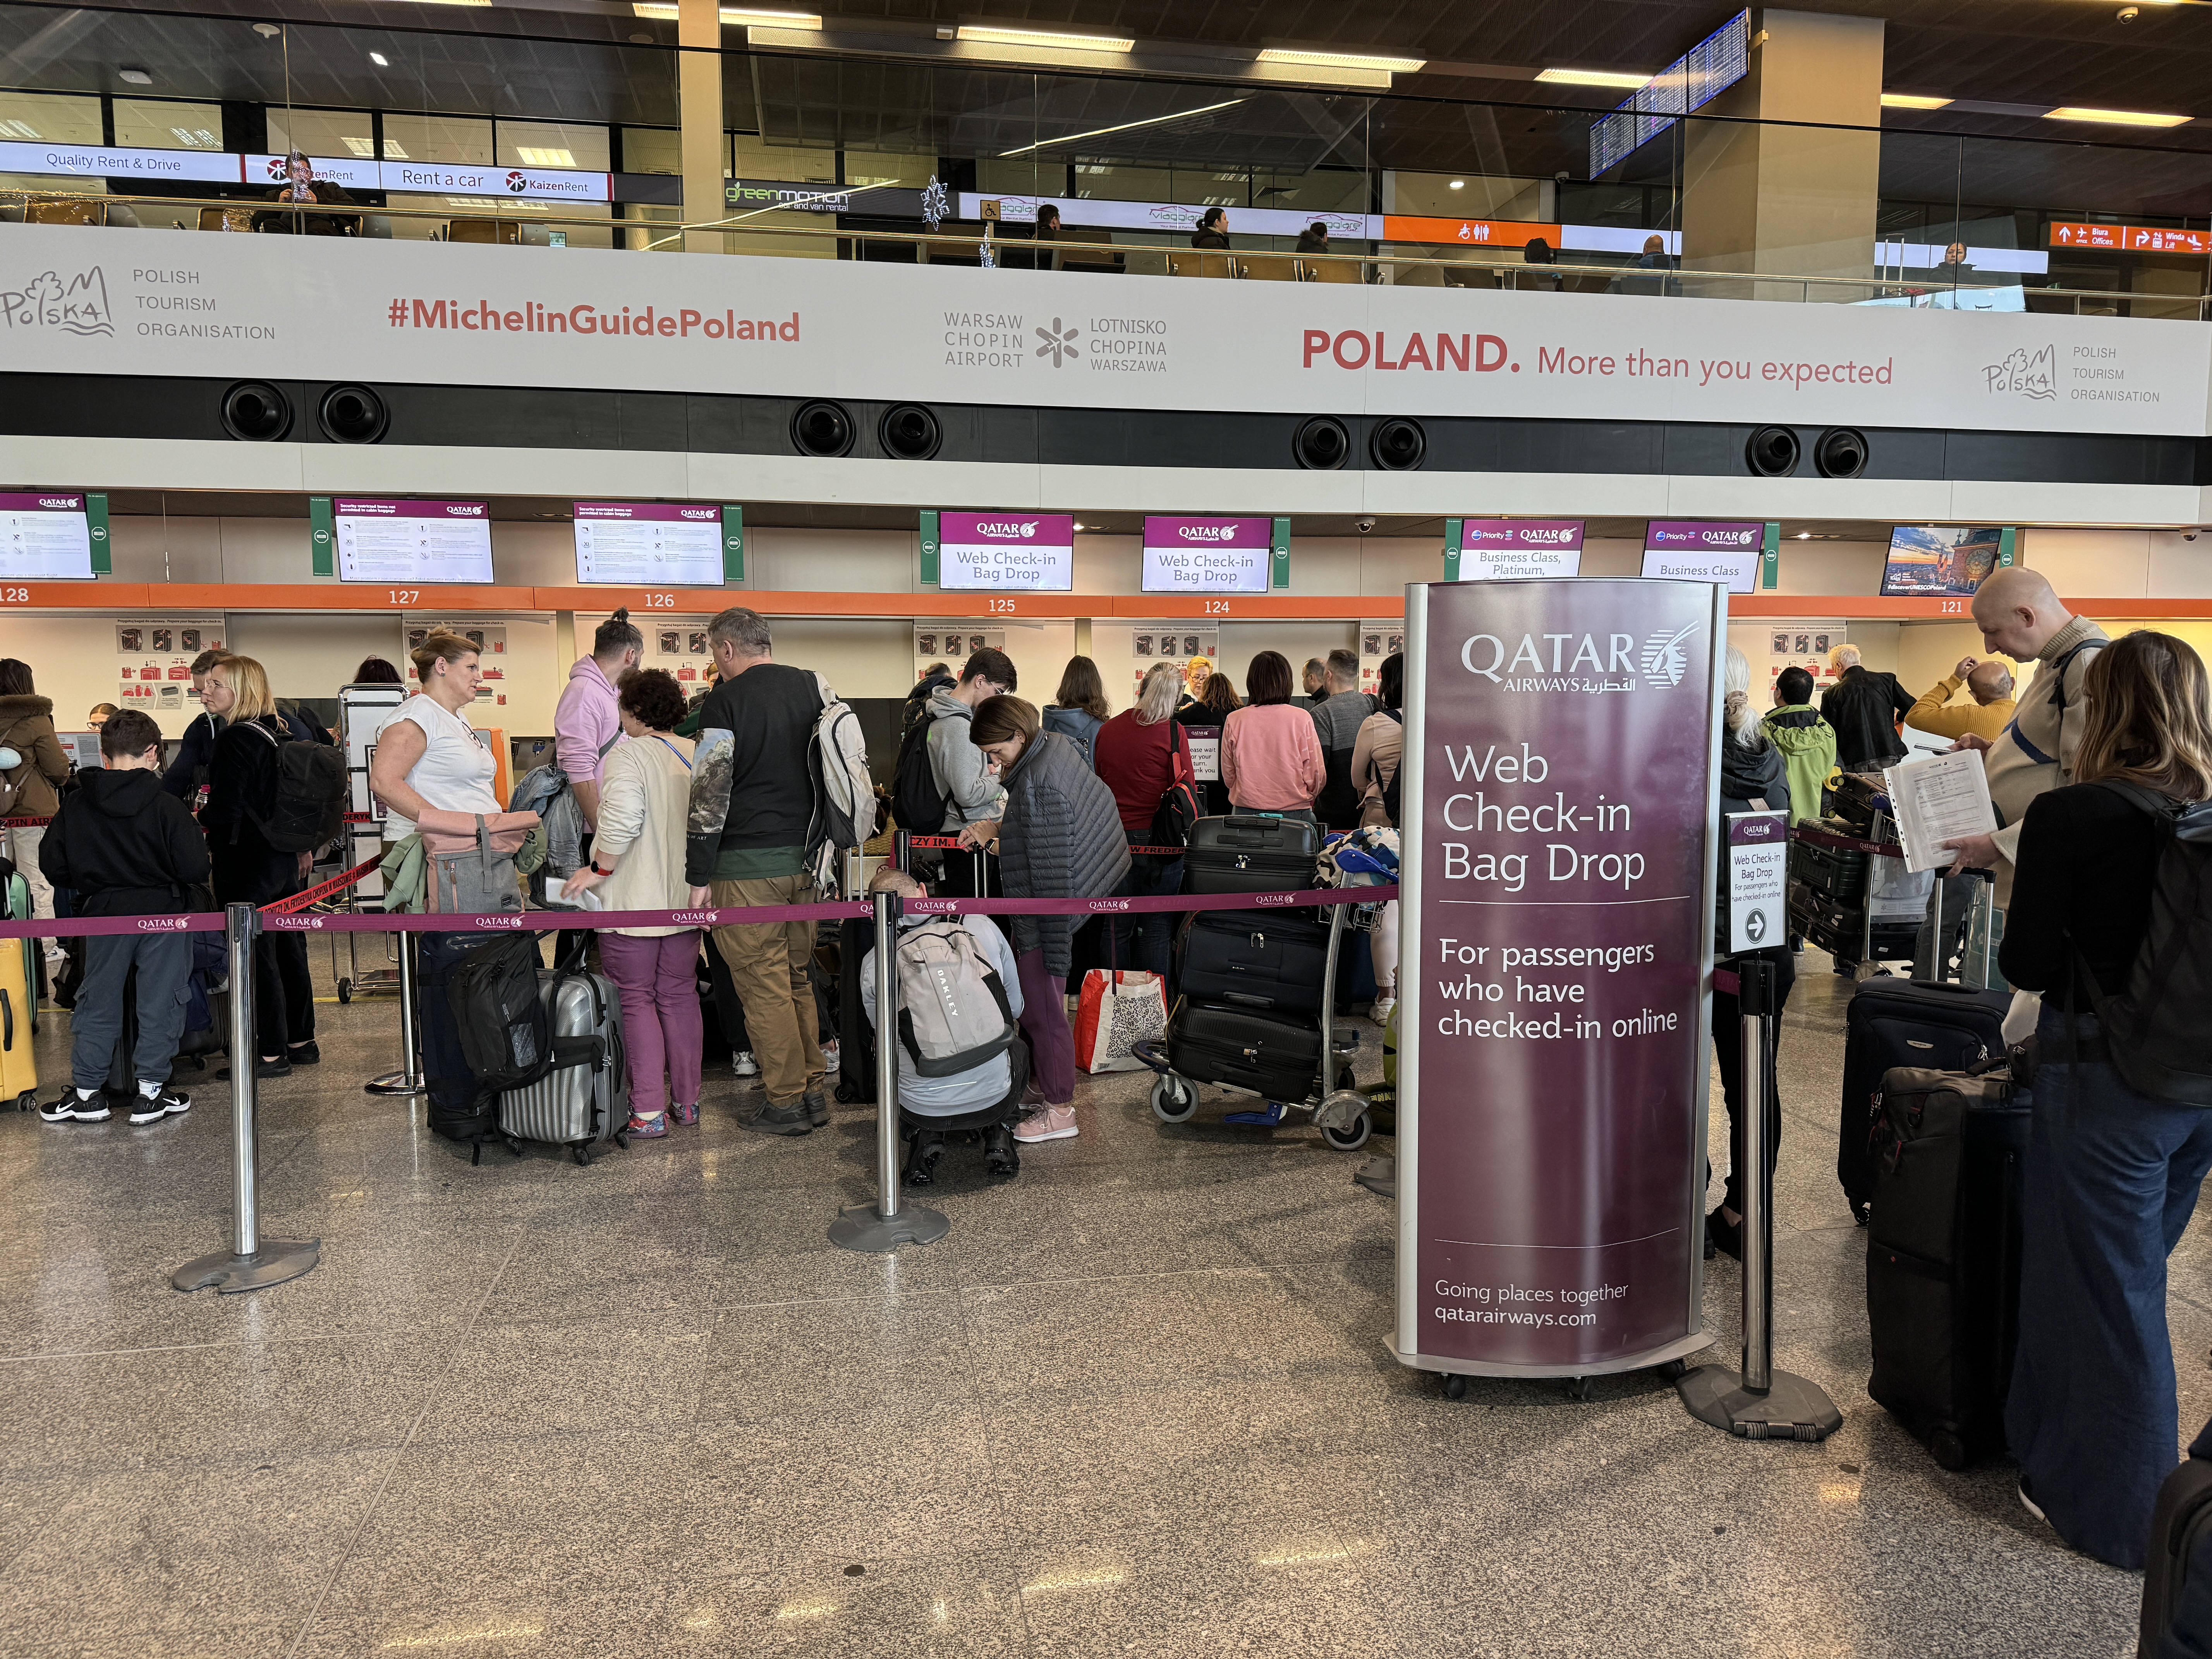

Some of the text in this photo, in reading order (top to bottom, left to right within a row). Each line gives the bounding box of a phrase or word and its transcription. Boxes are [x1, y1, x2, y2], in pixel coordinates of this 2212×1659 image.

[47, 153, 181, 170] Quality Rent & Drive
[403, 170, 484, 187] Rent a car
[530, 180, 588, 192] KaizenRent
[2092, 237, 2113, 246] Offices
[2166, 232, 2185, 240] Winda
[133, 269, 199, 284] POLISH
[136, 295, 216, 311] TOURISM
[388, 298, 800, 342] #MichelinGuidePoland
[944, 312, 1023, 329] WARSAW
[1091, 318, 1166, 334] LOTNISKO
[137, 323, 275, 339] ORGANISATION
[945, 332, 1023, 348] CHOPIN
[1091, 339, 1167, 355] CHOPINA
[945, 352, 1024, 368] AIRPORT
[1303, 329, 1893, 391] POLAND. More than you expected
[2074, 347, 2116, 359] POLISH
[1091, 359, 1167, 372] WARSZAWA
[2073, 368, 2124, 380] TOURISM
[2071, 389, 2160, 402] ORGANISATION
[977, 522, 1019, 535] QATAR
[1178, 526, 1219, 538] QATAR
[1520, 529, 1558, 541] QATAR
[1482, 532, 1504, 540] Priority
[1702, 531, 1738, 542] QATAR
[957, 551, 1056, 565] Web Check-in
[1159, 554, 1254, 568] Web Check-in
[1480, 552, 1561, 564] Business Class,
[972, 567, 1040, 583] Bag Drop
[1173, 570, 1237, 584] Bag Drop
[1493, 564, 1545, 576] Platinum,
[1660, 565, 1739, 576] Business Class
[0, 588, 29, 602] 128
[389, 590, 419, 604] 127
[645, 594, 674, 607] 126
[989, 599, 1016, 613] 125
[1204, 601, 1230, 613] 124
[1941, 601, 1962, 613] 121
[1461, 633, 1636, 684] QATAR
[1503, 678, 1580, 692] AIRWAYS
[1582, 678, 1636, 694] القطرية
[1445, 743, 1548, 783] Web
[1444, 792, 1630, 833] Check-in
[1743, 825, 1763, 834] QATAR
[933, 838, 950, 847] IM.
[1734, 852, 1780, 865] Web Check-in
[1442, 843, 1645, 892] Bag Drop
[1741, 868, 1773, 881] Bag Drop
[1743, 882, 1767, 891] passengers
[1256, 896, 1283, 904] QATAR
[1743, 892, 1766, 901] checked-in
[1089, 901, 1118, 909] QATAR
[138, 919, 174, 929] QATAR
[276, 917, 310, 926] QATAR
[476, 917, 509, 927] QATAR
[672, 913, 705, 922] QATAR
[1439, 938, 1654, 973] For passengers
[937, 969, 958, 1017] OAKLEY
[1439, 974, 1585, 1003] who have
[1438, 1008, 1677, 1039] checked-in online
[1435, 1279, 1628, 1307] Going places together
[1434, 1306, 1596, 1328] qatarairways.com
